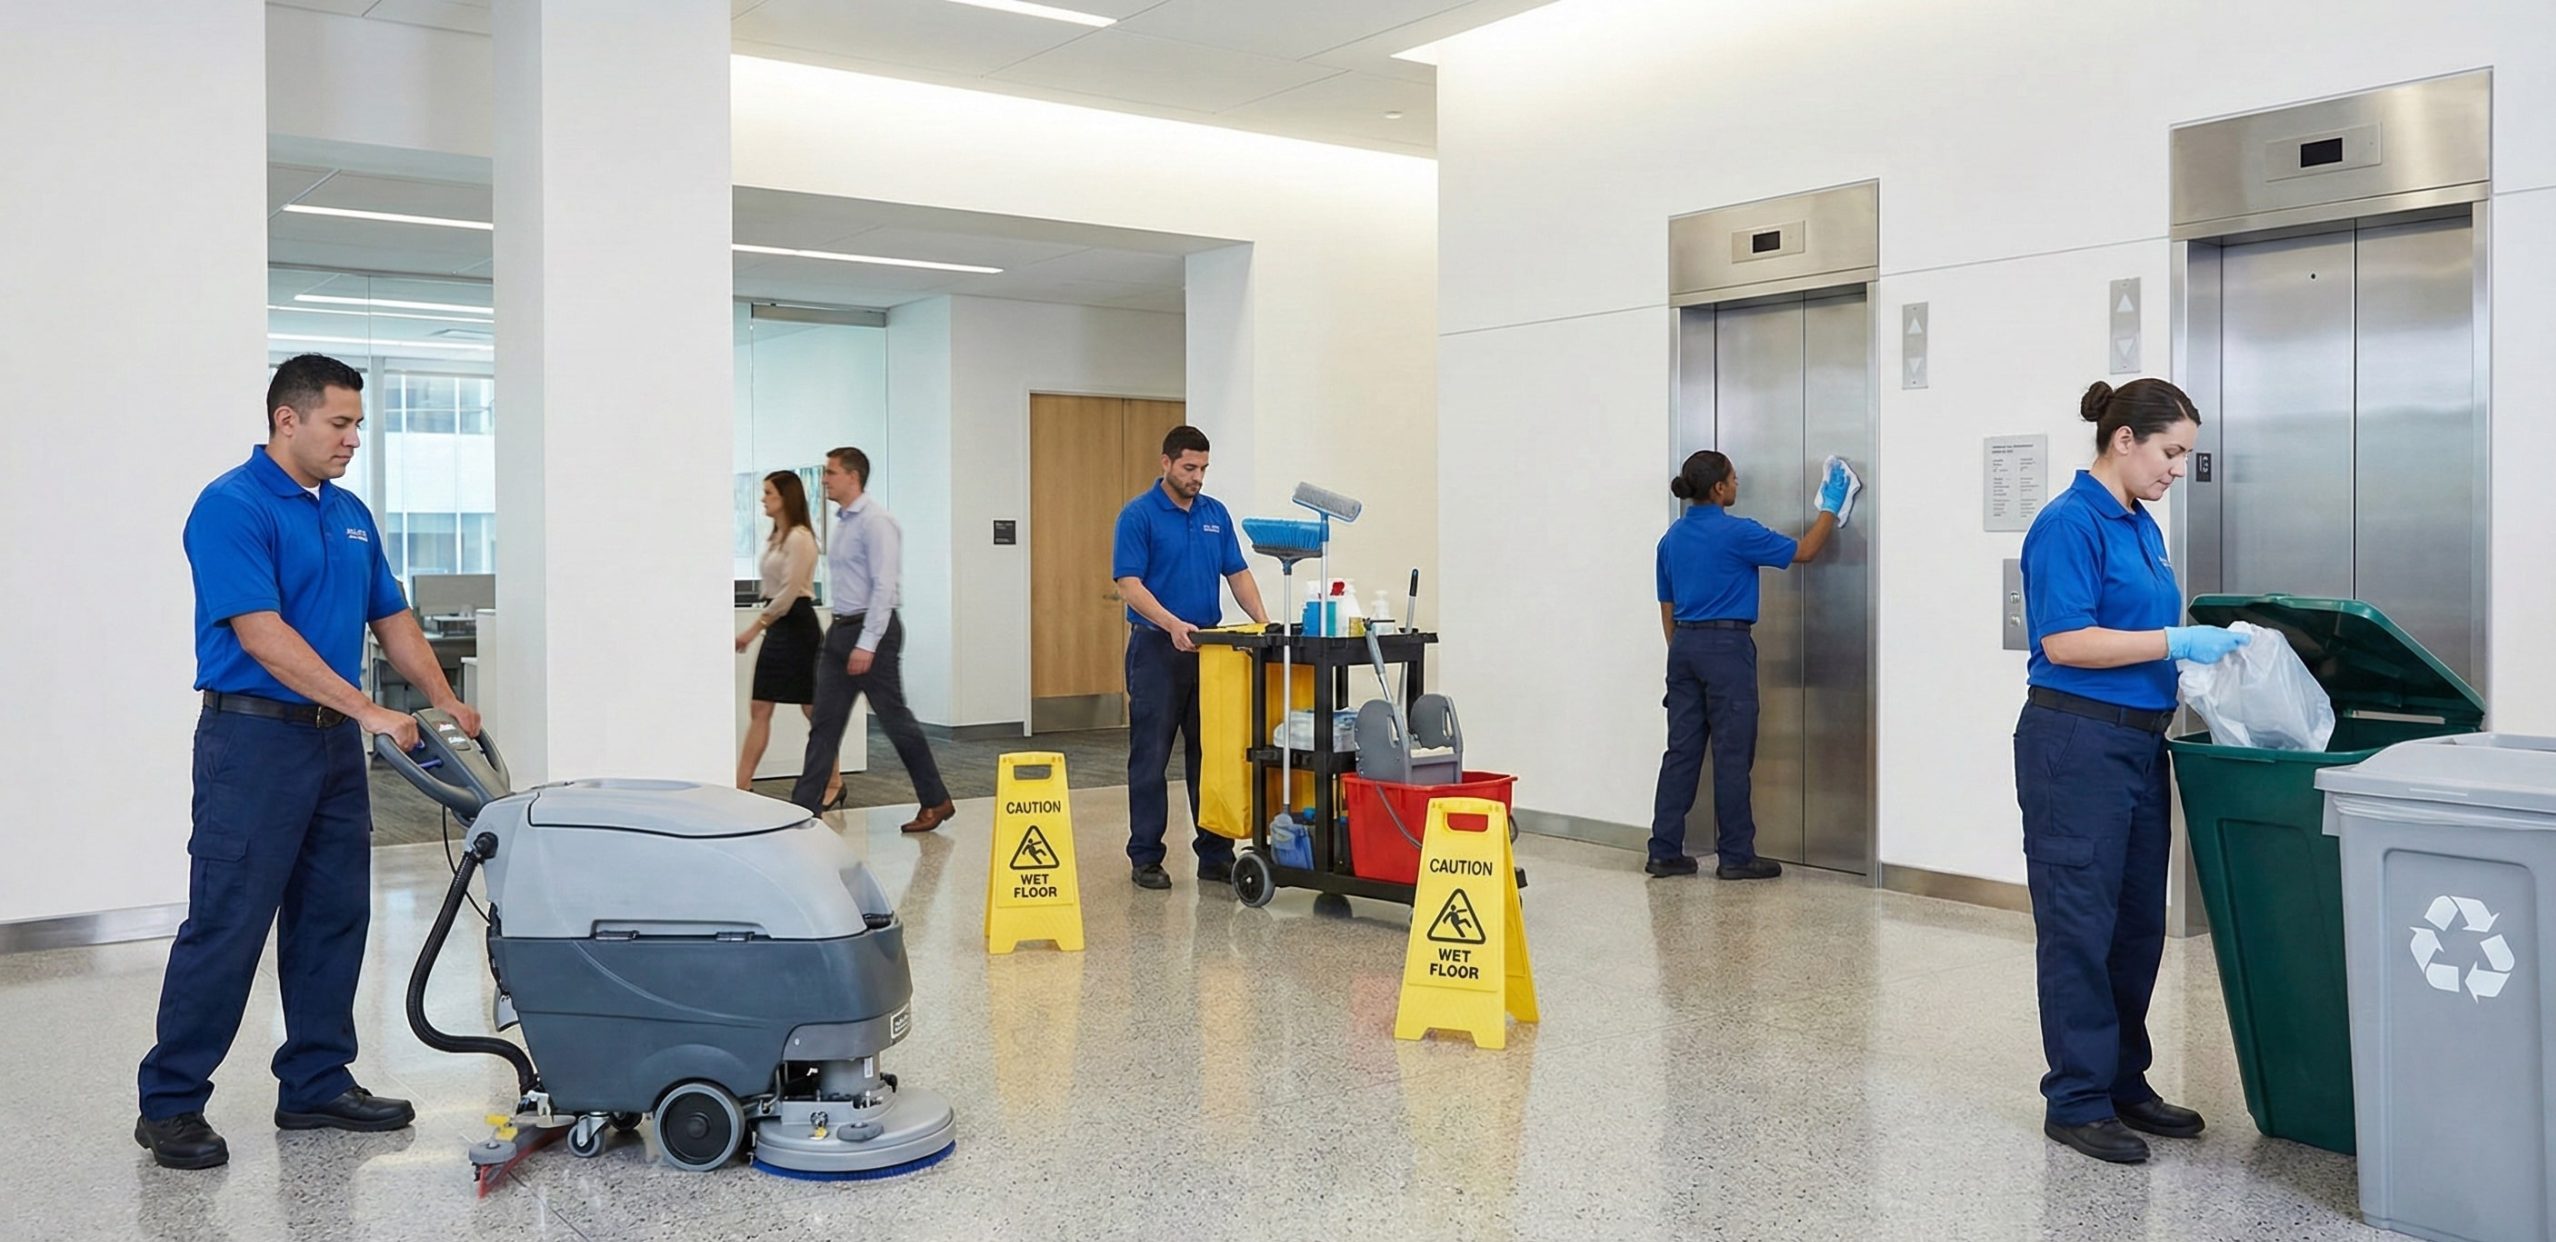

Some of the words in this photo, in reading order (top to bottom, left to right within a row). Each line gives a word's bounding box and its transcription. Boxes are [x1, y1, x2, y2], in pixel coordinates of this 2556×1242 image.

[1006, 800, 1061, 815] CAUTION
[1429, 858, 1493, 876] CAUTION
[1020, 873, 1049, 885] WET
[1014, 886, 1058, 898] FLOOR
[1438, 948, 1471, 963] WET
[1429, 963, 1479, 979] FLOOR
